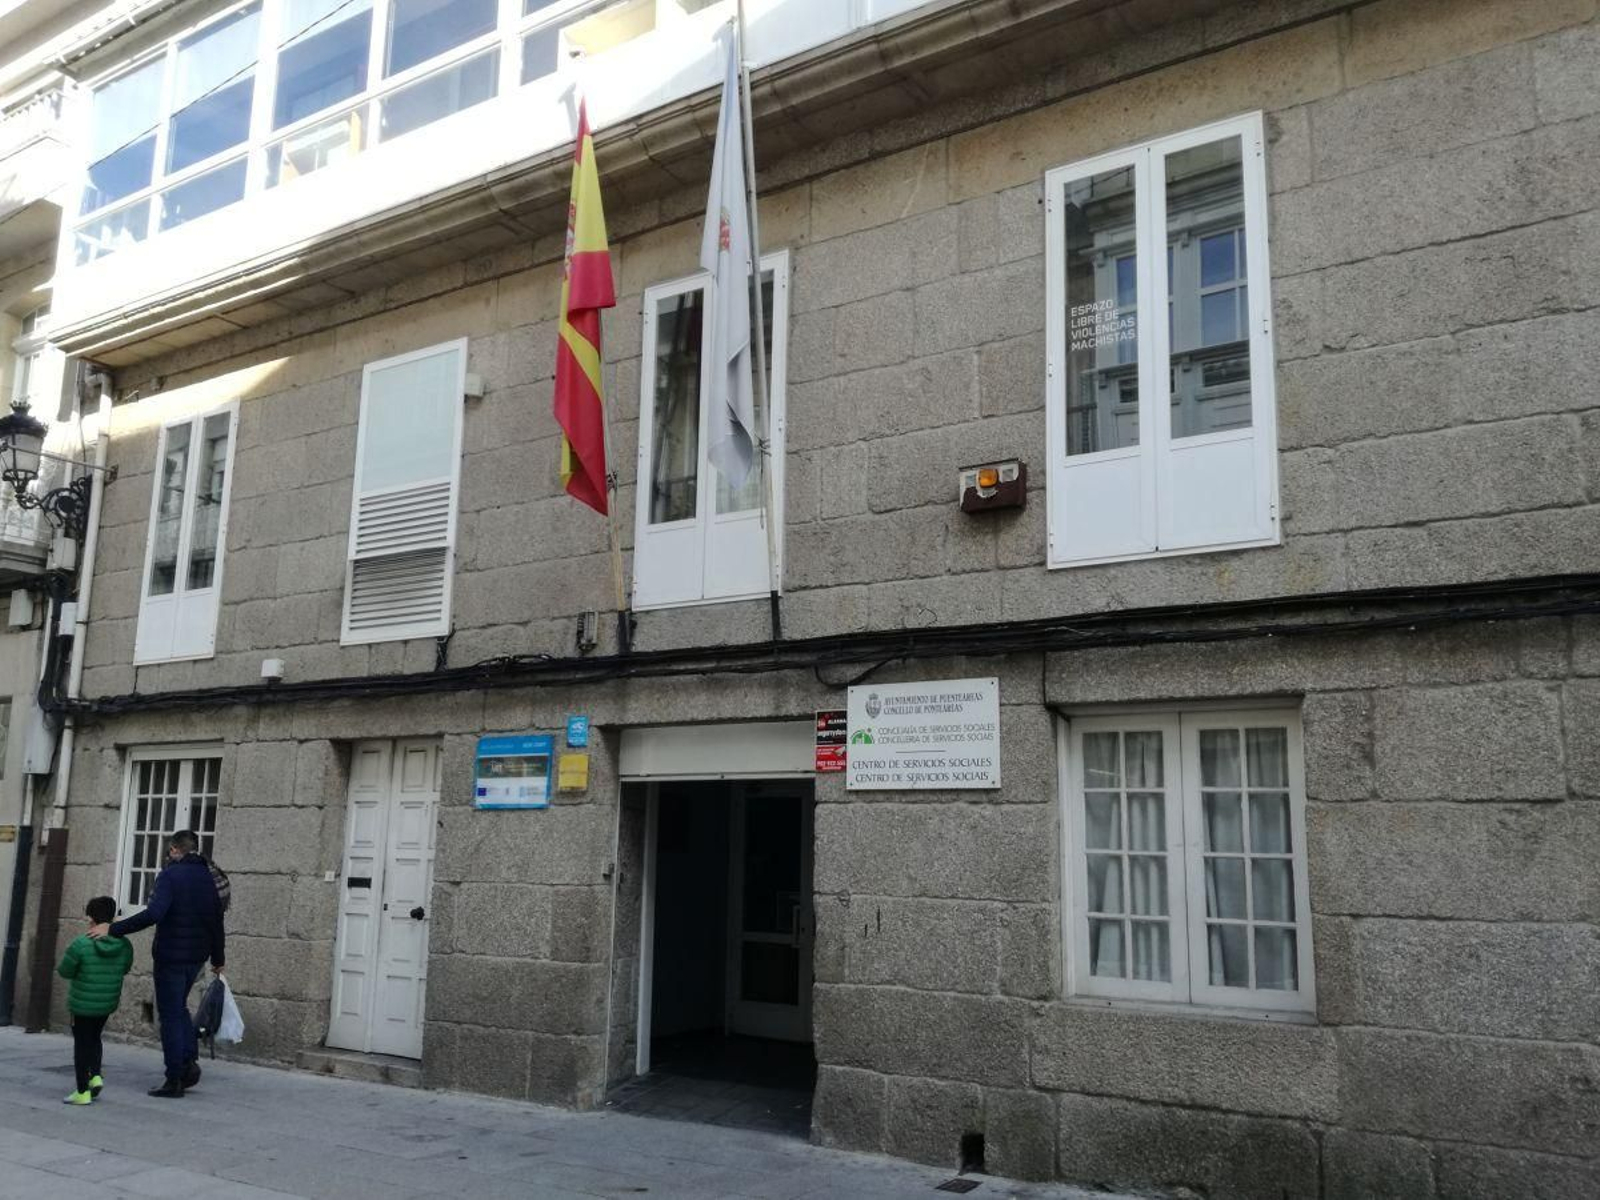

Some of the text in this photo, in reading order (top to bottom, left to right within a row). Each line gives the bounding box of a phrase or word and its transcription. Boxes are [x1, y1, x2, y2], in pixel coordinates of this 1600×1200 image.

[1071, 299, 1113, 316] ESPAZO
[1071, 309, 1119, 329] LIBRE DE
[1071, 317, 1135, 340] VIOLENCIAS
[1071, 329, 1135, 351] MACHISTAS
[884, 706, 913, 715] CONCELLO
[915, 706, 922, 714] DE
[919, 726, 928, 734] DE
[930, 725, 962, 734] SERVICIOS
[964, 723, 995, 732] SOCIALES
[922, 735, 930, 743] DE
[932, 734, 965, 743] SERVICIOS
[852, 760, 886, 770] CENTRO
[890, 759, 900, 769] DE
[903, 759, 945, 768] SERVICIOS
[949, 758, 992, 767] SOCIALES
[855, 771, 989, 783] CENTRO DE SERVICIOS SOCIAIS
